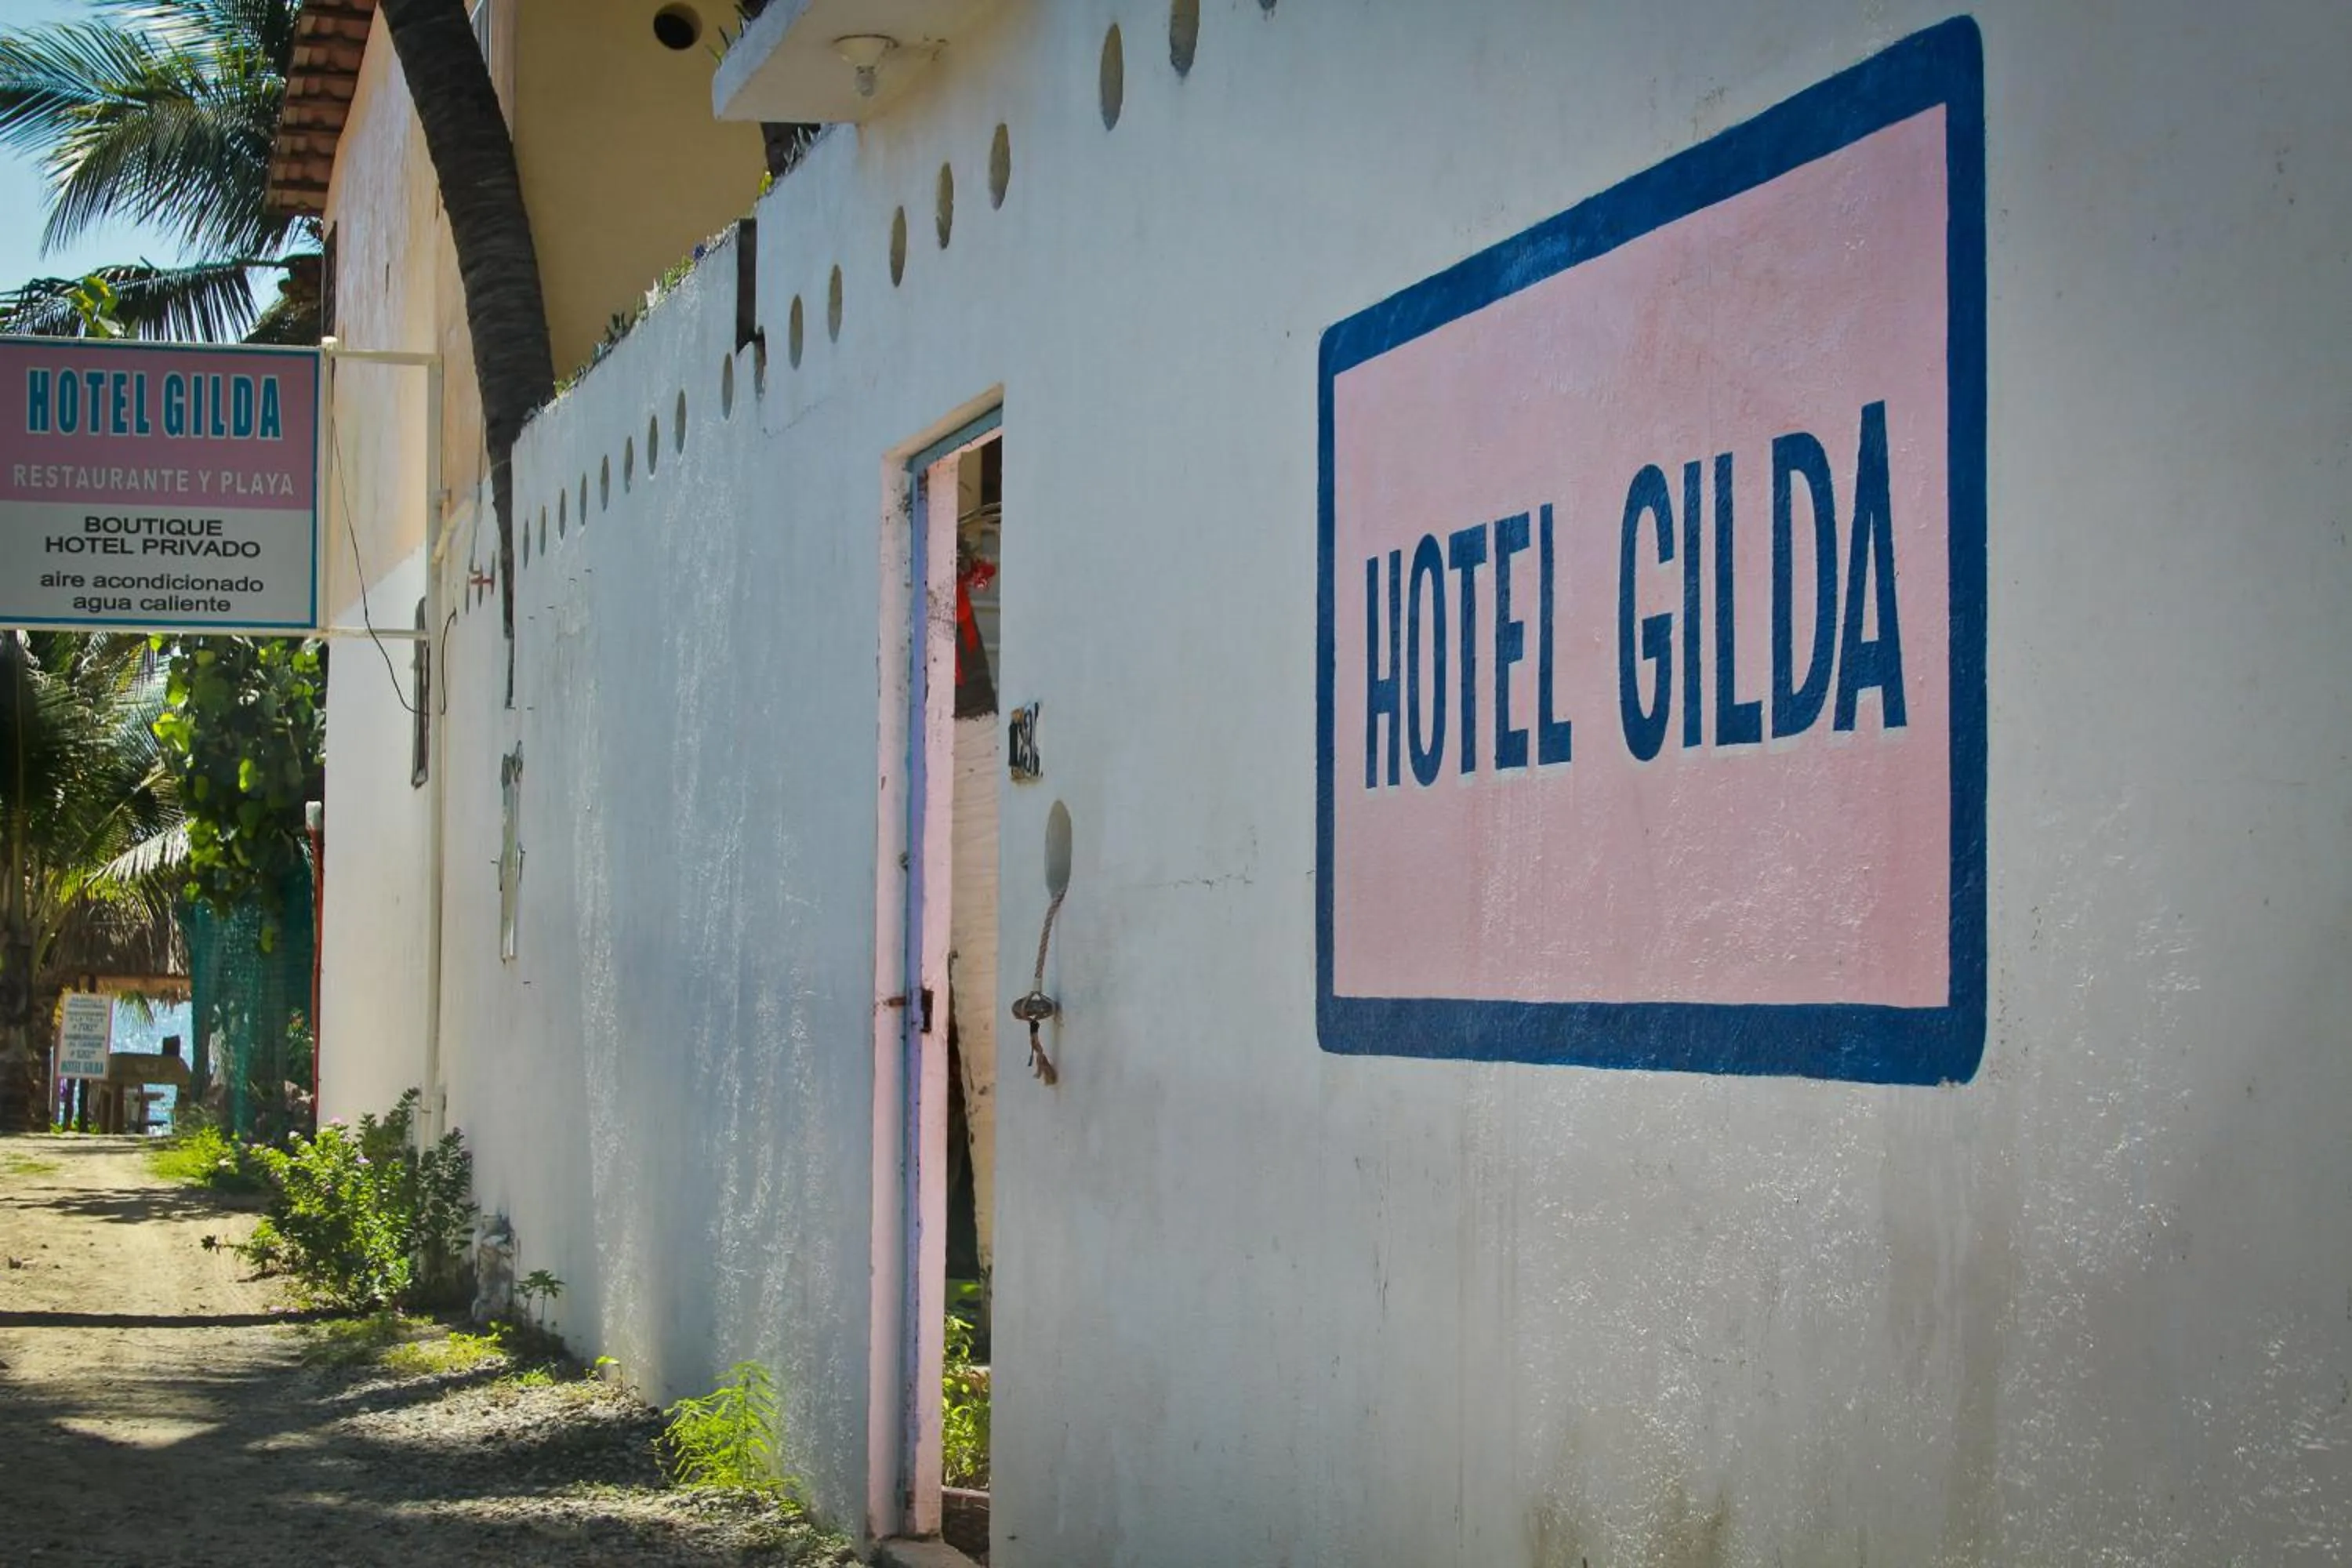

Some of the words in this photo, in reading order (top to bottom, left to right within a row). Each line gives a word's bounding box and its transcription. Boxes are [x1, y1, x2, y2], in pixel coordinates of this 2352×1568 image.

[26, 367, 151, 435] HOTEL
[162, 370, 283, 439] GILDA
[13, 464, 189, 492] RESTAURANTE
[199, 470, 215, 492] Y
[221, 473, 294, 495] PLAYA
[84, 516, 223, 537] BOUTIQUE
[45, 536, 134, 555] HOTEL
[142, 538, 261, 558] PRIVADO
[40, 572, 85, 588] aire
[93, 572, 264, 593] acondicionado
[73, 596, 132, 613] agua
[140, 595, 230, 612] caliente
[1366, 503, 1571, 789] HOTEL
[1619, 399, 1907, 762] GILDA
